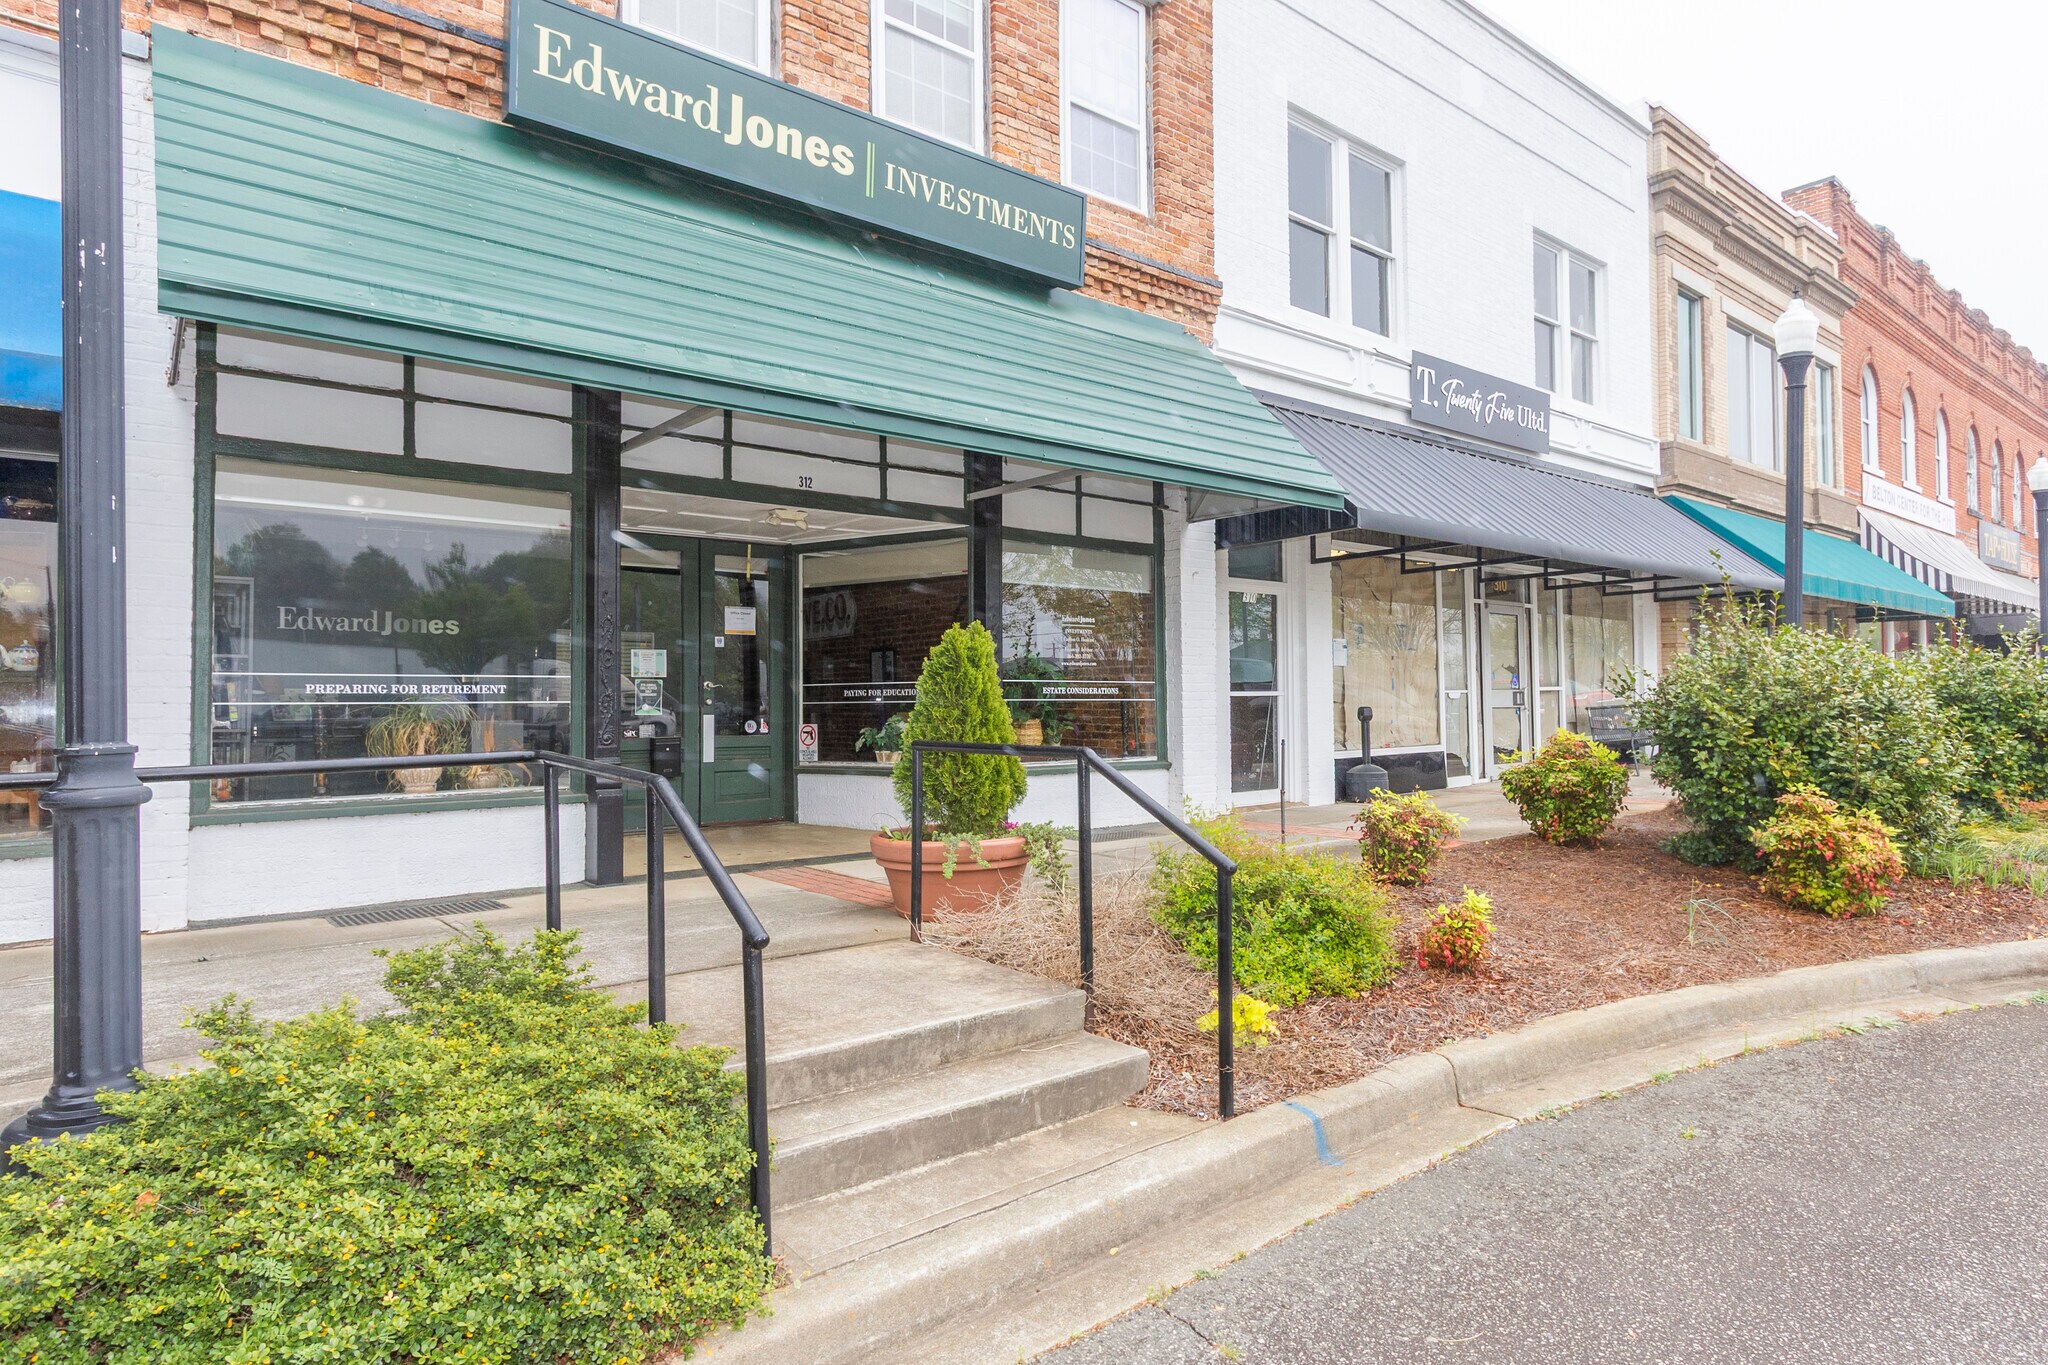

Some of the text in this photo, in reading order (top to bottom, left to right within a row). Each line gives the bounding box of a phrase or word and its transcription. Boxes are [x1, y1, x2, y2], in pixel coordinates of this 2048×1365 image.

[884, 161, 1076, 250] INVESTMENTS
[1416, 365, 1548, 434] T. Twenty Five Ultd.
[798, 475, 813, 489] 312
[1872, 484, 1896, 506] BELTON
[1897, 494, 1919, 514] CENTER
[1493, 580, 1508, 592] 310
[304, 683, 507, 695] PREPARING FOR RETIREMENT
[843, 689, 868, 697] PAYING
[868, 689, 882, 697] FOR
[1066, 687, 1119, 695] CONSIDERATIONS
